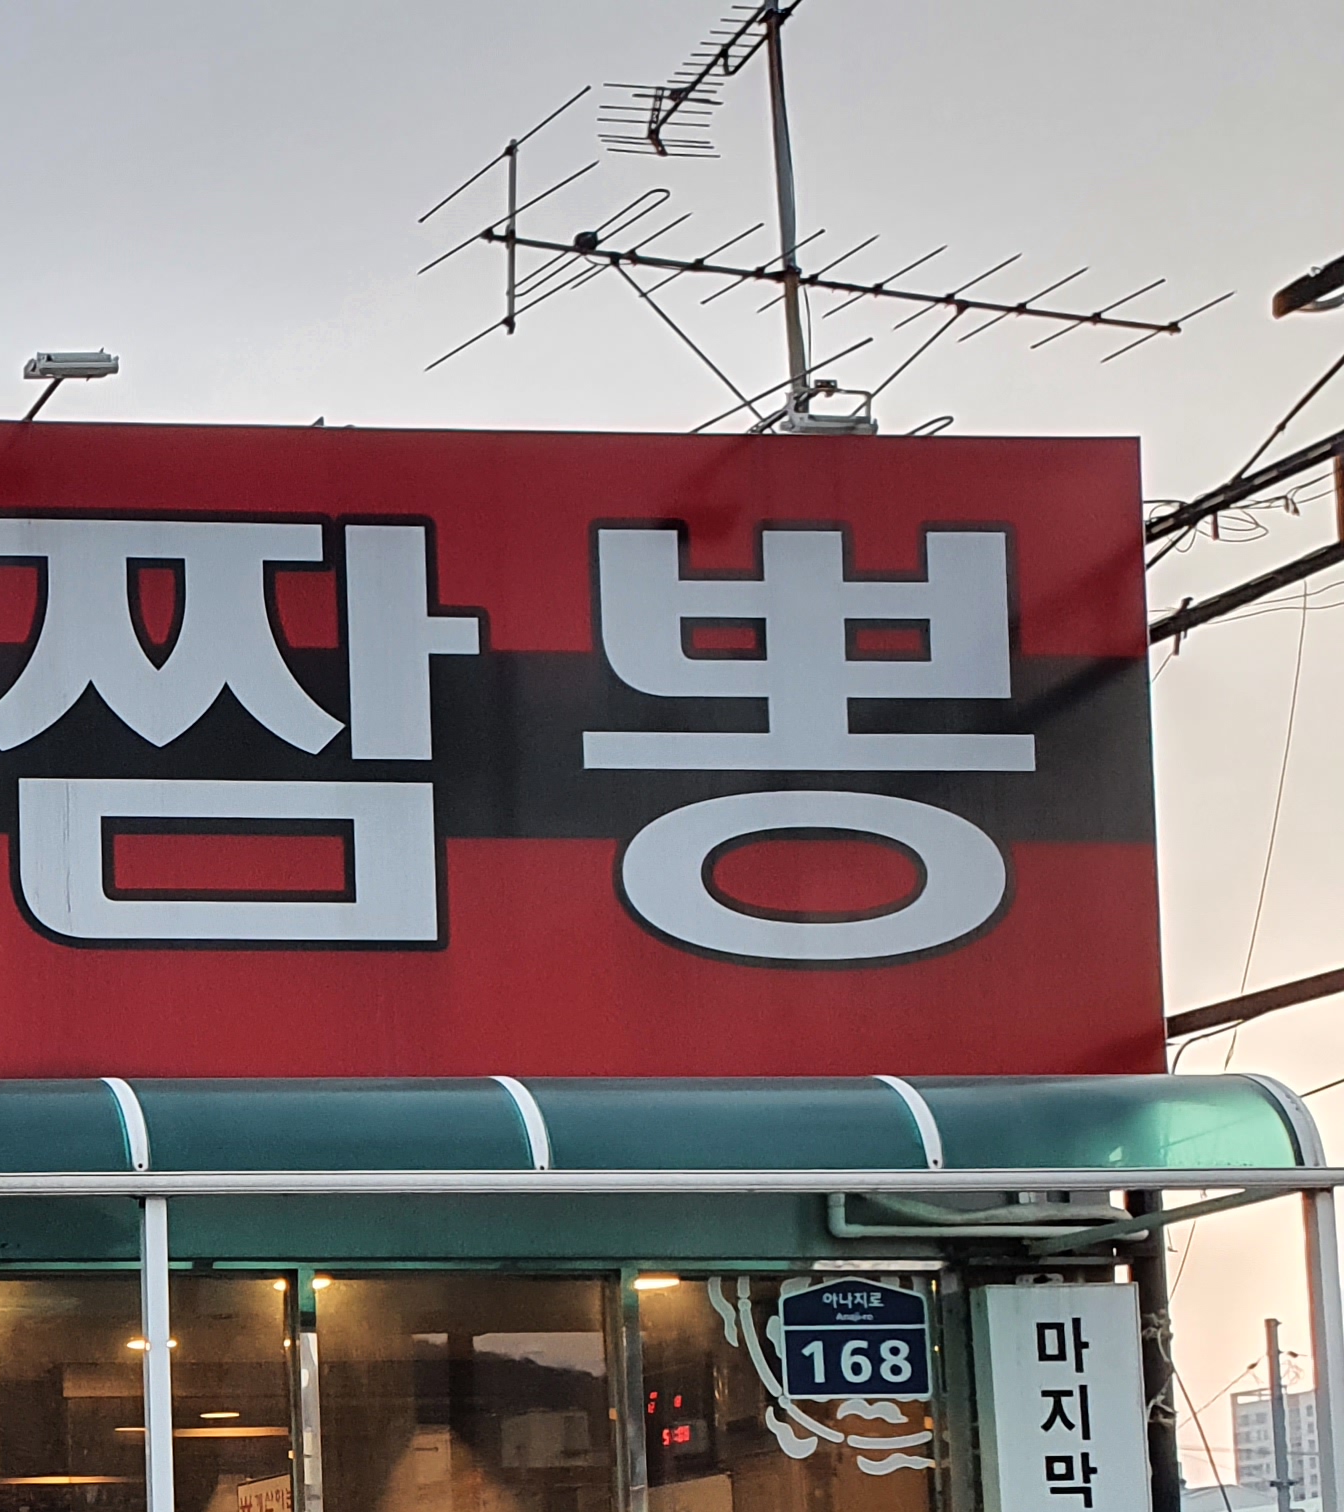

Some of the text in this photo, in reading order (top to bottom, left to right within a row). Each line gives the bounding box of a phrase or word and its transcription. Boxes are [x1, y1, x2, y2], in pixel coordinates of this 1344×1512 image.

[822, 1292, 885, 1309] 아나지로
[801, 1340, 912, 1383] 168
[1036, 1317, 1099, 1508] 마지막
